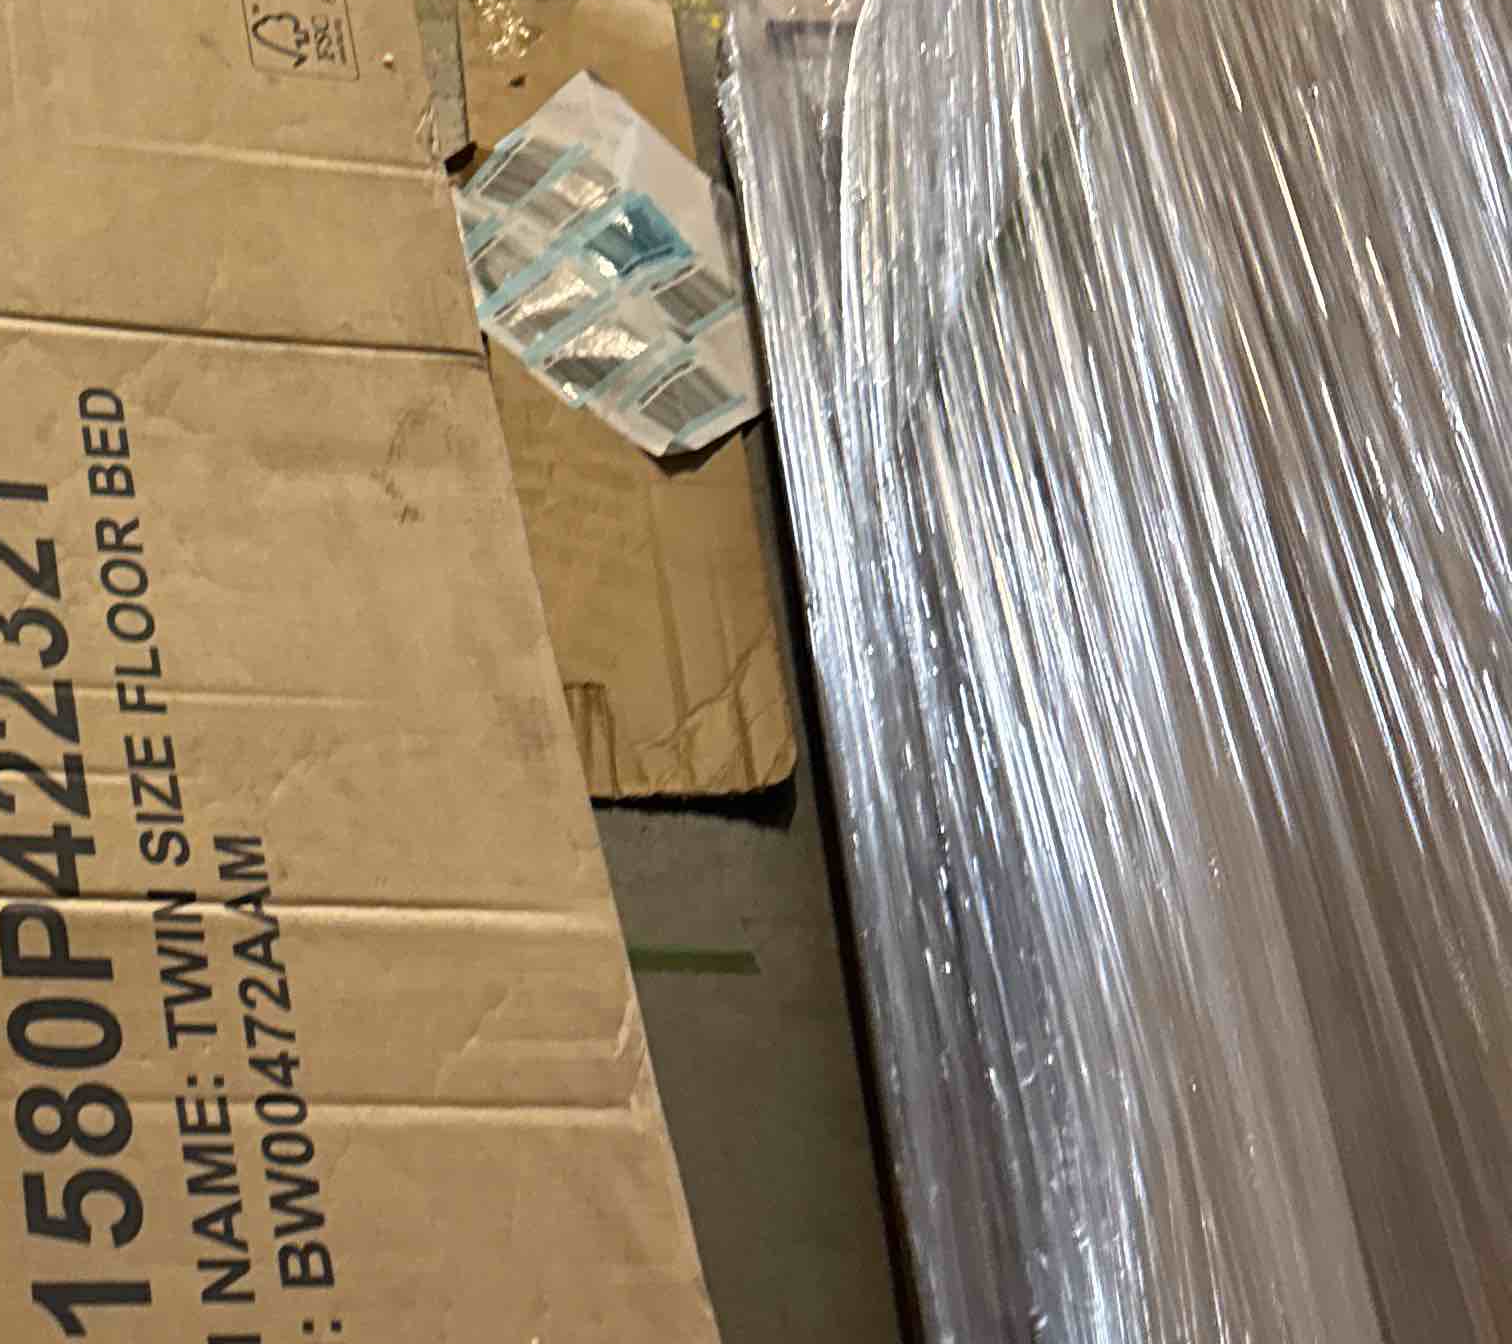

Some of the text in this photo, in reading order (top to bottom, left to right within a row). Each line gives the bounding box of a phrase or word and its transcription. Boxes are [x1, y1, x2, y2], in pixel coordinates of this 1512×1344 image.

[78, 387, 136, 498] BED
[95, 517, 168, 714] FLOOR
[123, 736, 191, 867] SIZE
[147, 890, 218, 1049] TWIN
[214, 836, 335, 1289] BW00472AAM
[175, 1074, 255, 1304] NAME:
